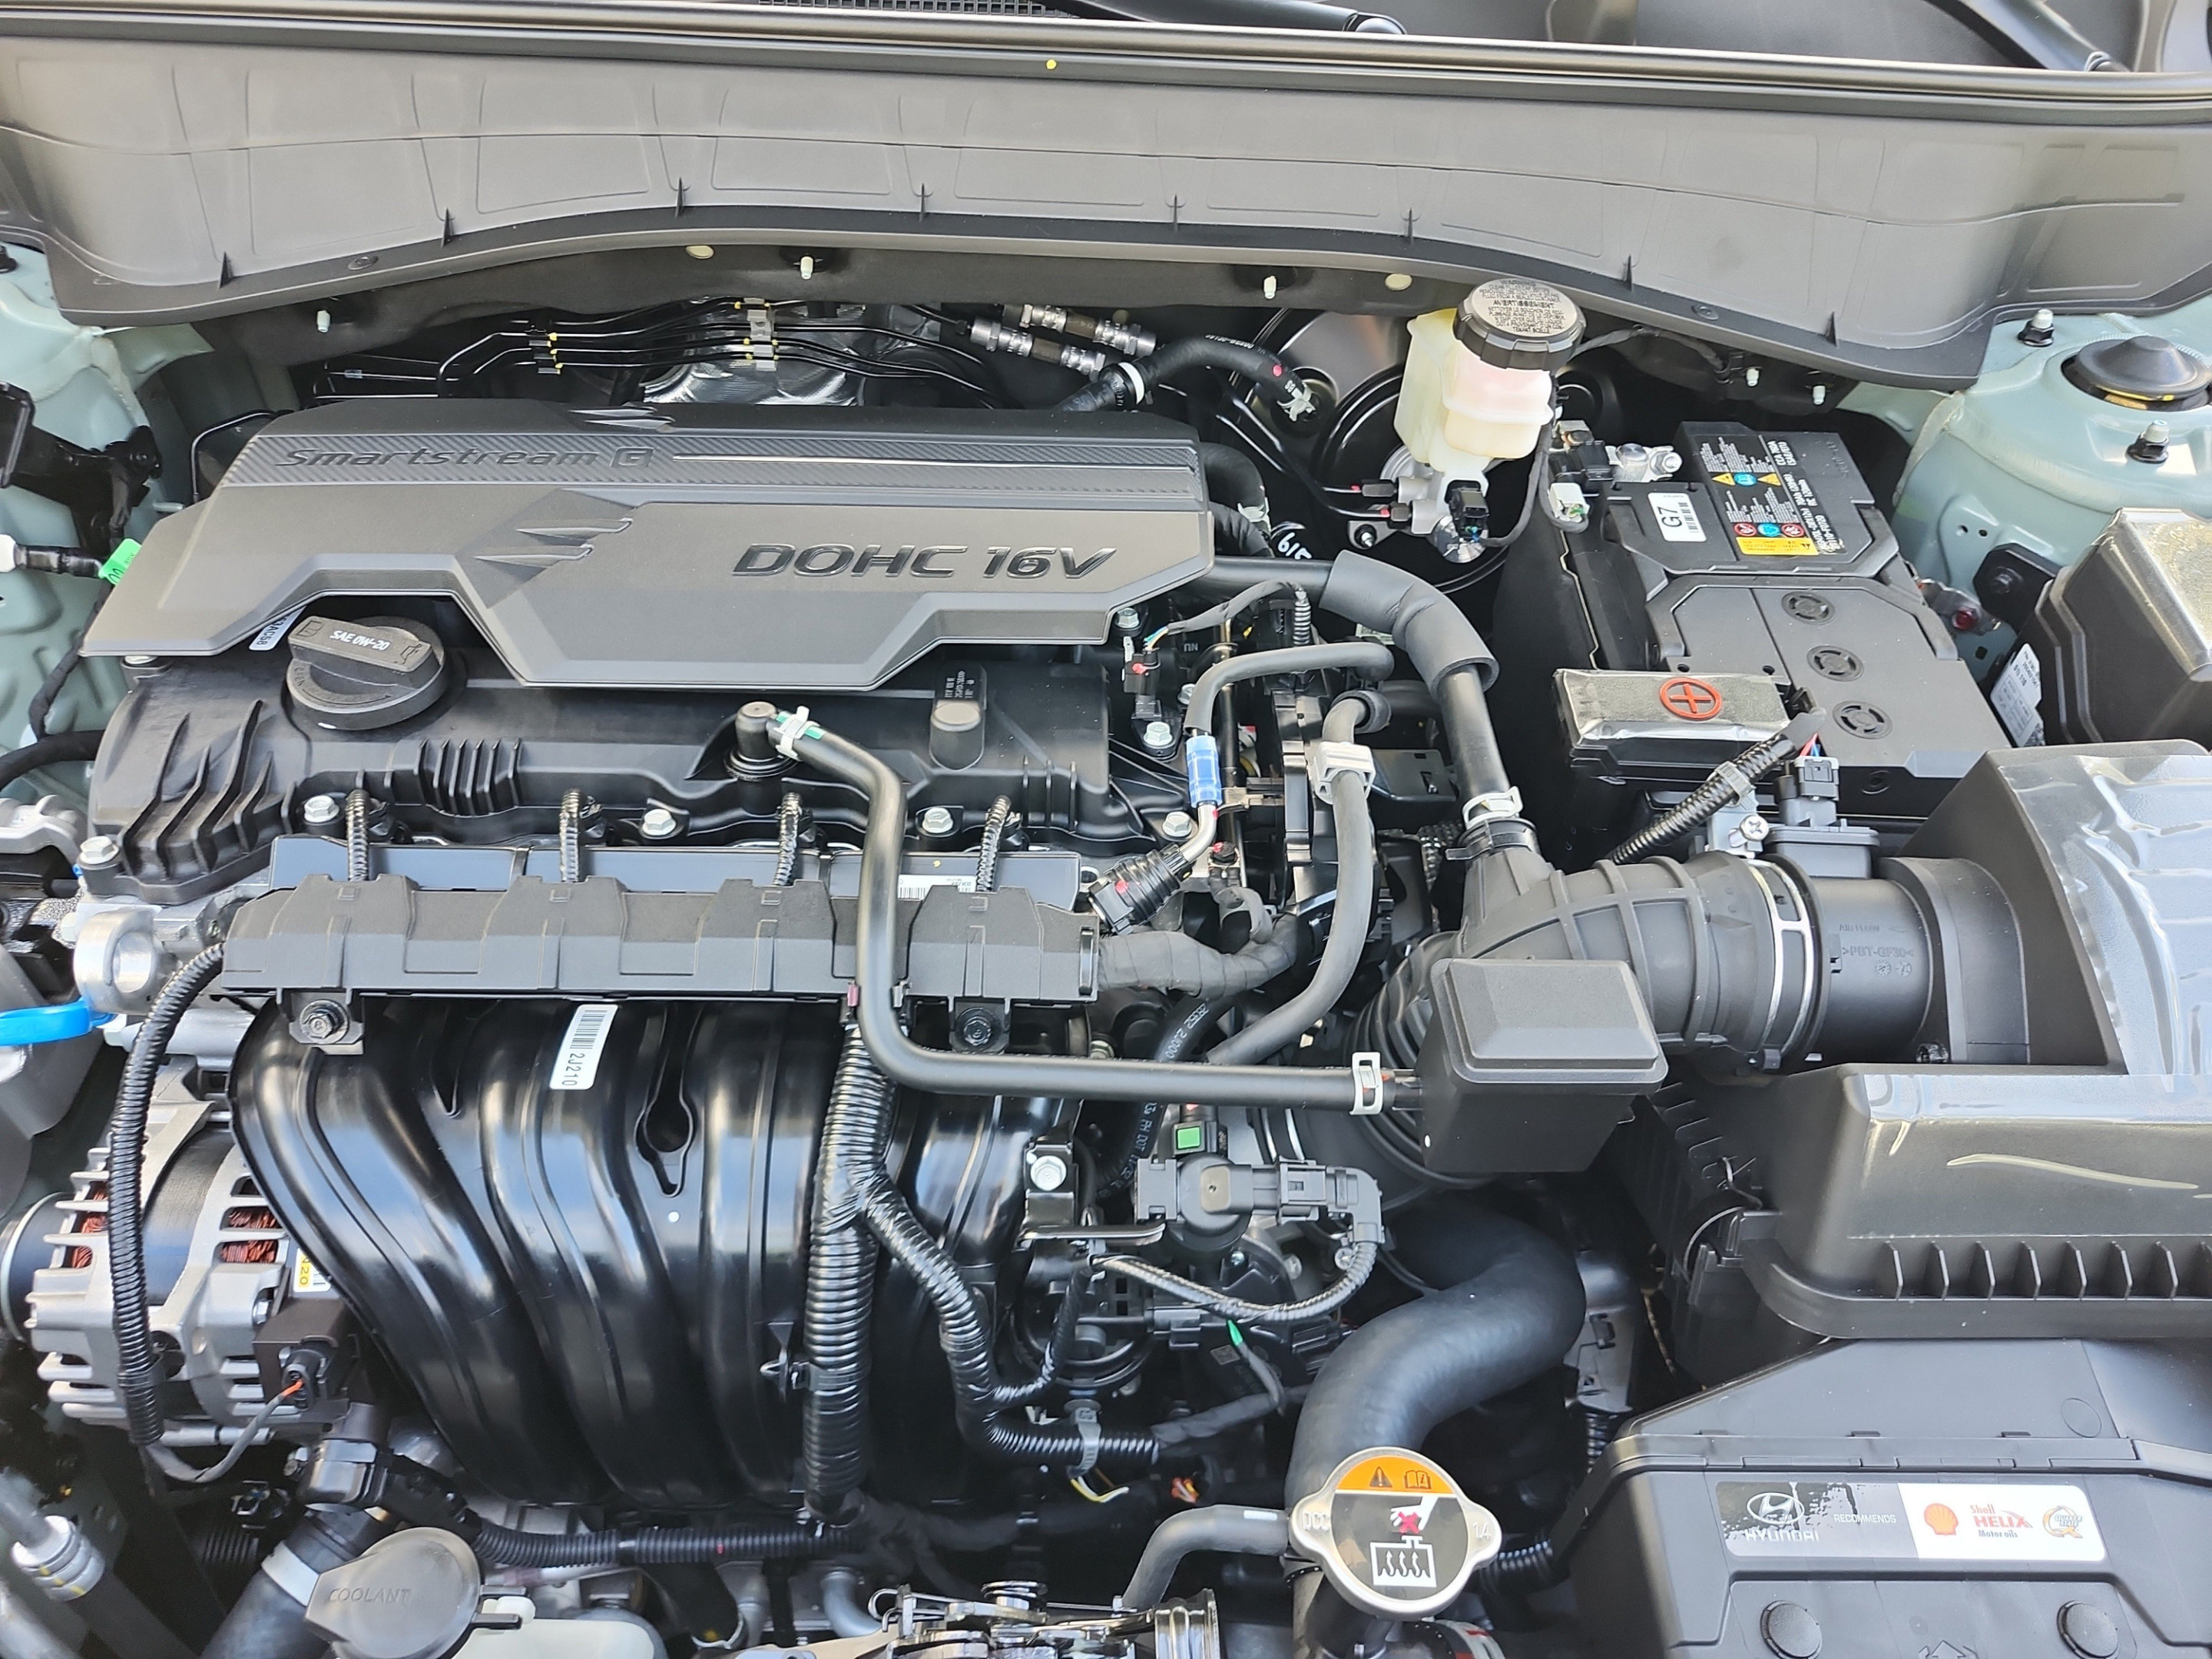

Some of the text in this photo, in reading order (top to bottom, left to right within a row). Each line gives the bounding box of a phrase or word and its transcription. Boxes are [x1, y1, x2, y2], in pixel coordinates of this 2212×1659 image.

[275, 447, 602, 466] Smartstream
[1657, 506, 1682, 528] G7
[732, 543, 1117, 579] DOHC 16V
[329, 630, 390, 651] SAE 0W-20
[561, 1053, 586, 1086] 2J210
[1970, 1503, 1996, 1515] Shell
[1833, 1514, 1897, 1524] RECOMMENDS
[1973, 1515, 2032, 1528] HELIX
[1744, 1528, 1820, 1542] HYUNDAI
[1978, 1529, 2018, 1538] Motor oils
[328, 1588, 412, 1604] COOLANT
